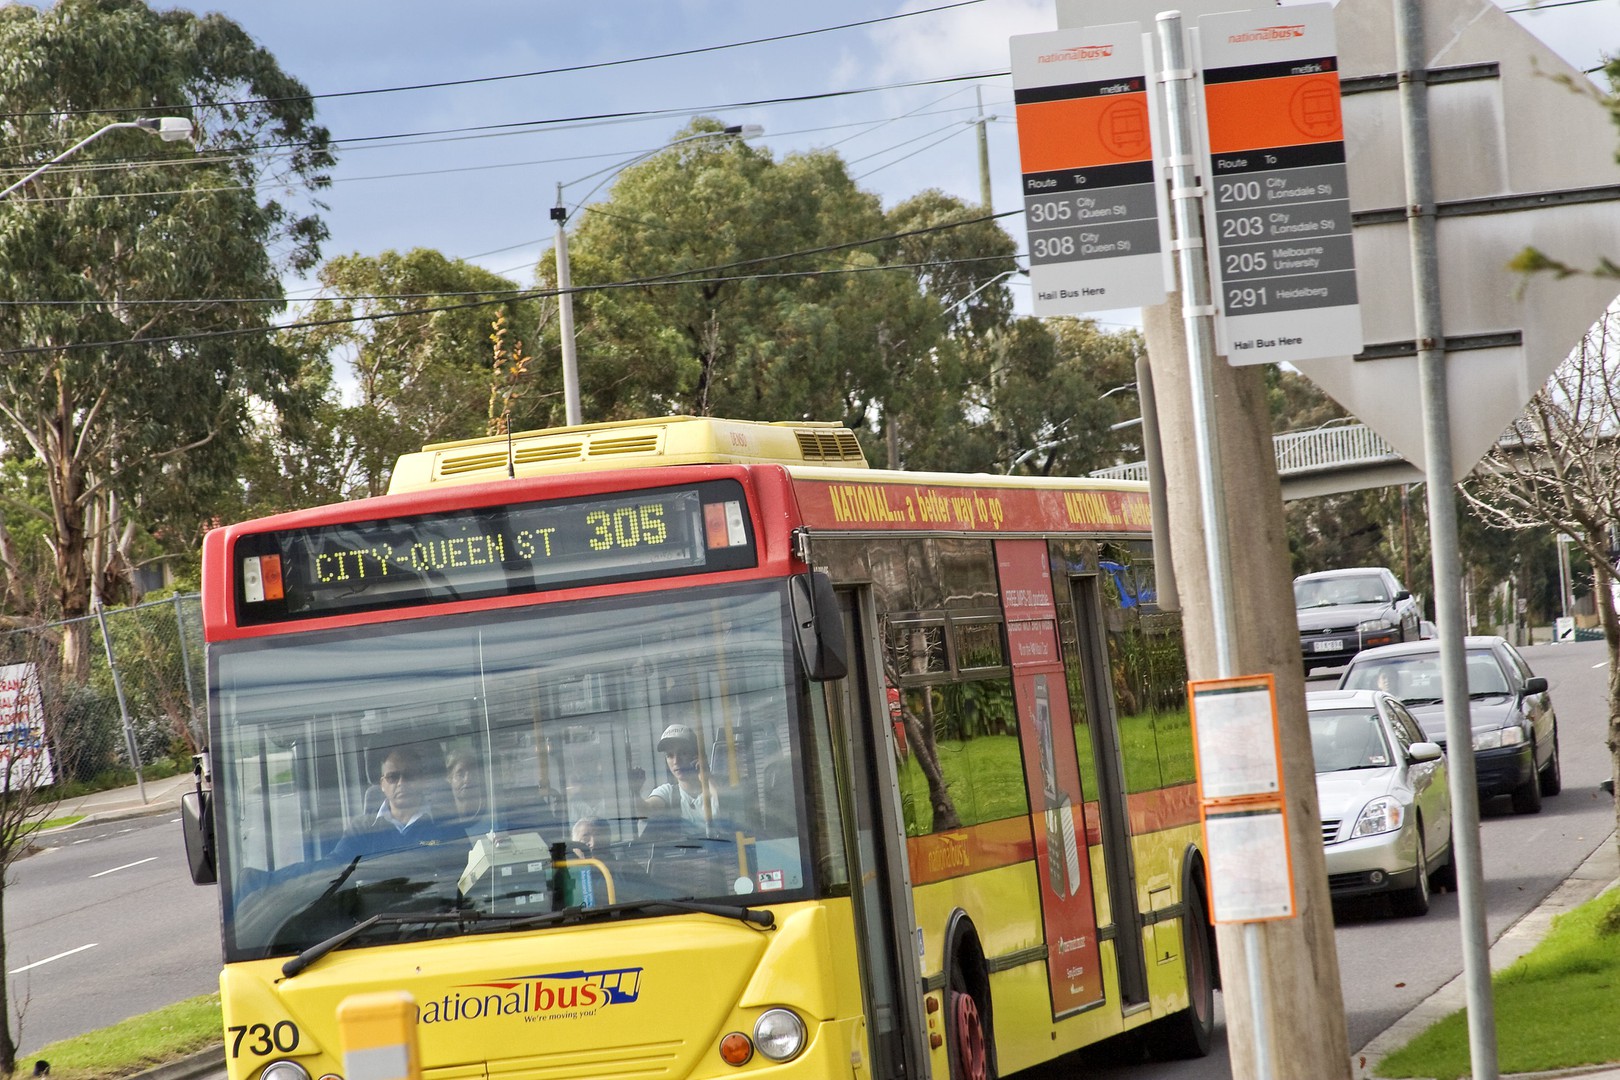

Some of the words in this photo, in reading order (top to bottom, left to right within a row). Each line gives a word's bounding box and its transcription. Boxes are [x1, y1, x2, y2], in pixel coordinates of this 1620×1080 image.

[1291, 63, 1322, 75] metlink
[1100, 84, 1130, 95] metlink
[1217, 158, 1248, 169] Route
[1264, 154, 1277, 164] To
[1027, 178, 1058, 189] Route
[1073, 174, 1087, 184] To
[1266, 177, 1287, 189] City
[1219, 180, 1261, 203] 200
[1266, 186, 1316, 200] (Lonsdale
[1316, 184, 1333, 195] St)
[1076, 197, 1096, 209] City
[1030, 200, 1072, 223] 305
[1077, 207, 1112, 220] (Queen
[1112, 204, 1127, 216] St)
[1268, 212, 1290, 224] City
[1222, 216, 1264, 238] 203
[1269, 222, 1319, 236] (Lonsdale
[1319, 219, 1336, 231] St)
[1079, 232, 1100, 244] City
[1033, 235, 1075, 258] 308
[1080, 242, 1116, 256] (Queen
[1116, 240, 1131, 251] St)
[1272, 246, 1324, 258] Melbourne
[1225, 251, 1267, 274] 205
[1273, 257, 1320, 270] University
[1038, 290, 1058, 300] Hail
[1060, 289, 1079, 299] Bus
[1081, 286, 1106, 297] Here
[1228, 287, 1268, 309] 291
[1275, 286, 1329, 299] Heidelberg
[1234, 340, 1254, 350] Hail
[1256, 338, 1276, 348] Bus
[1278, 336, 1303, 347] Here
[828, 485, 905, 522] NATIONAL...
[905, 495, 917, 523] a
[914, 487, 951, 523] better
[950, 497, 976, 530] way
[973, 490, 989, 523] to
[988, 497, 1004, 530] go
[1120, 502, 1130, 526] a
[315, 533, 506, 583] CITY-QUEEN
[516, 527, 556, 559] ST
[586, 502, 667, 551] 305
[524, 1014, 547, 1023] We're
[549, 1011, 578, 1021] moving
[579, 1008, 597, 1018] you!
[228, 1019, 300, 1058] 730
